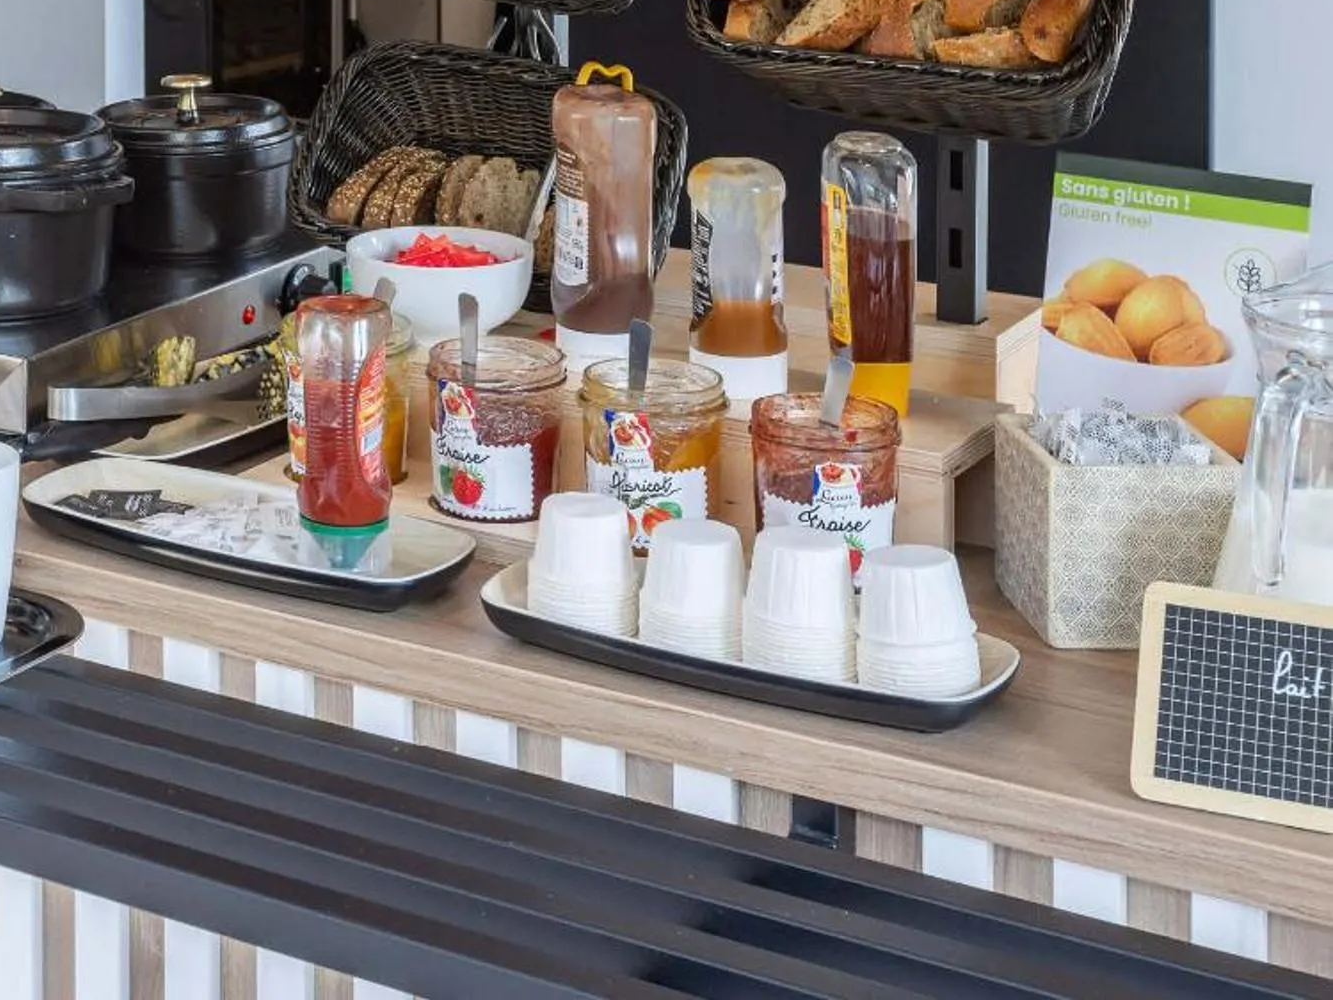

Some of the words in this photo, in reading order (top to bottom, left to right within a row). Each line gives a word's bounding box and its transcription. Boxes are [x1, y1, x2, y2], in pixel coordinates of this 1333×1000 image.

[1061, 178, 1110, 200] Sans
[1112, 187, 1180, 210] gluten
[1058, 202, 1112, 223] Gluten
[797, 504, 872, 533] Fraise
